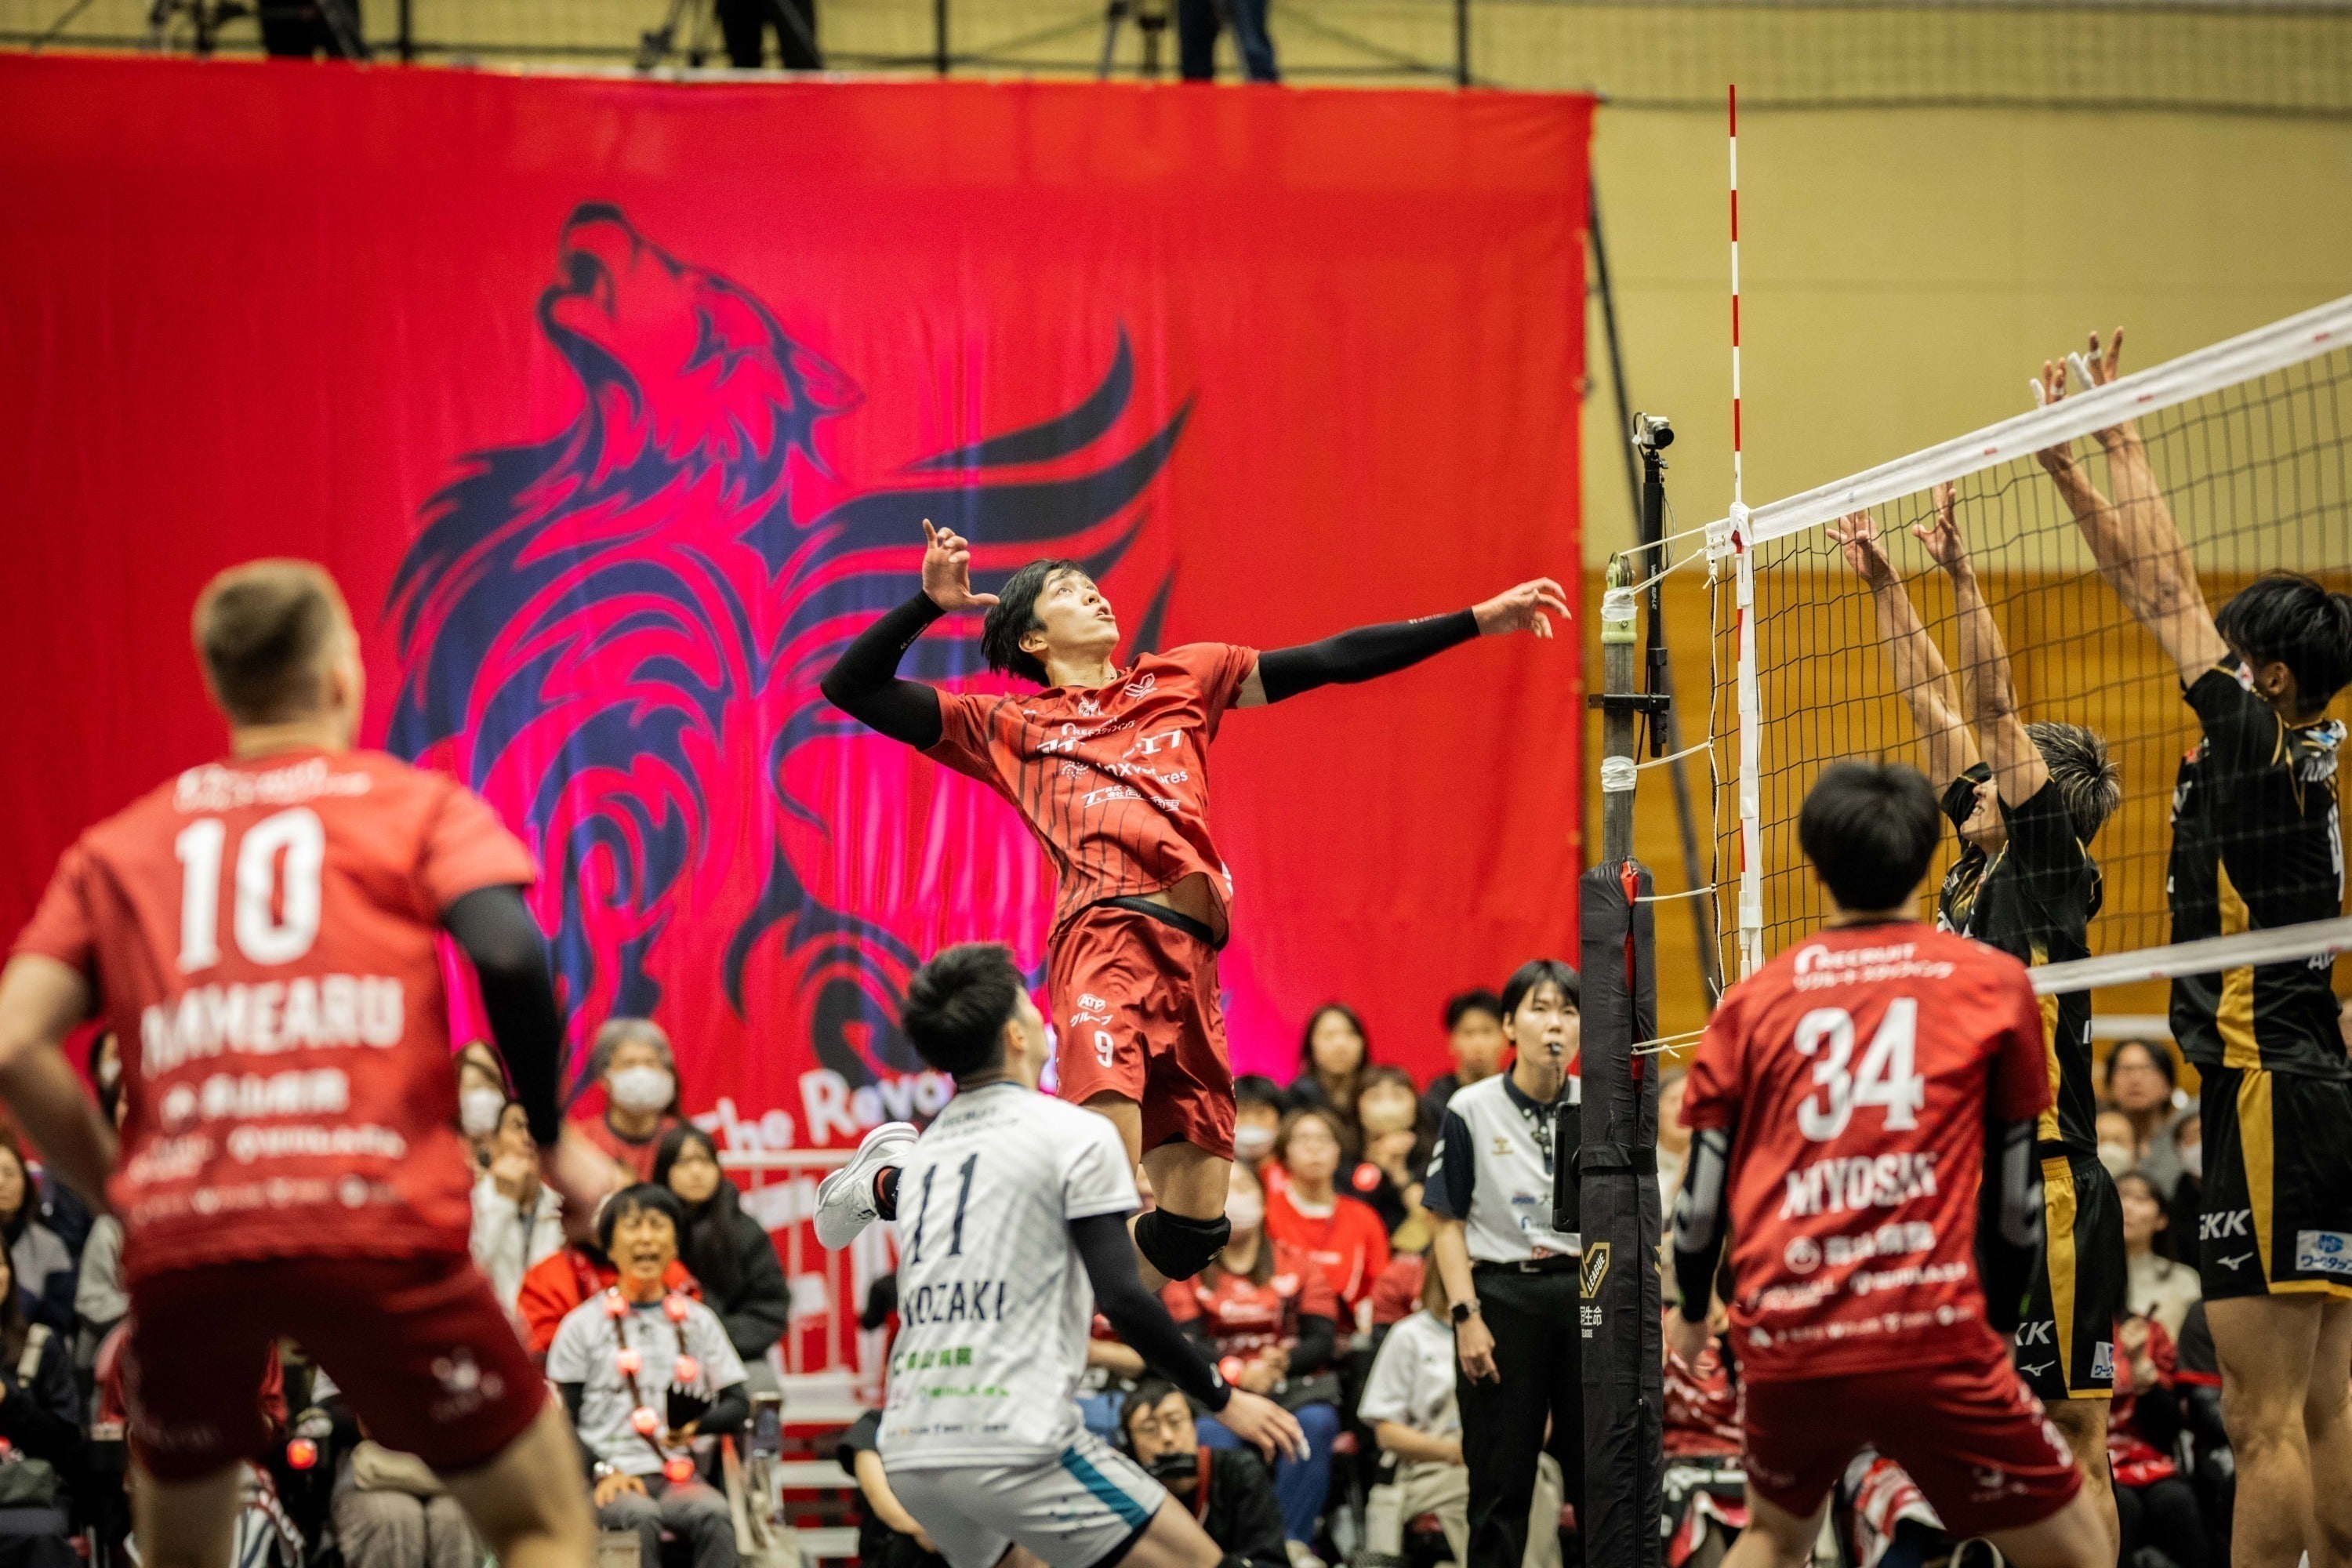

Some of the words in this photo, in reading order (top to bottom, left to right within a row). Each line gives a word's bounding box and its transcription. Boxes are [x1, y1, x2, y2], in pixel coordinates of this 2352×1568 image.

[176, 806, 326, 974] 10
[1094, 1030, 1114, 1068] 9
[1794, 996, 1925, 1142] 34
[798, 1068, 957, 1146] Revo
[912, 1153, 978, 1265] 11
[1586, 1252, 1606, 1292] LEAGUE
